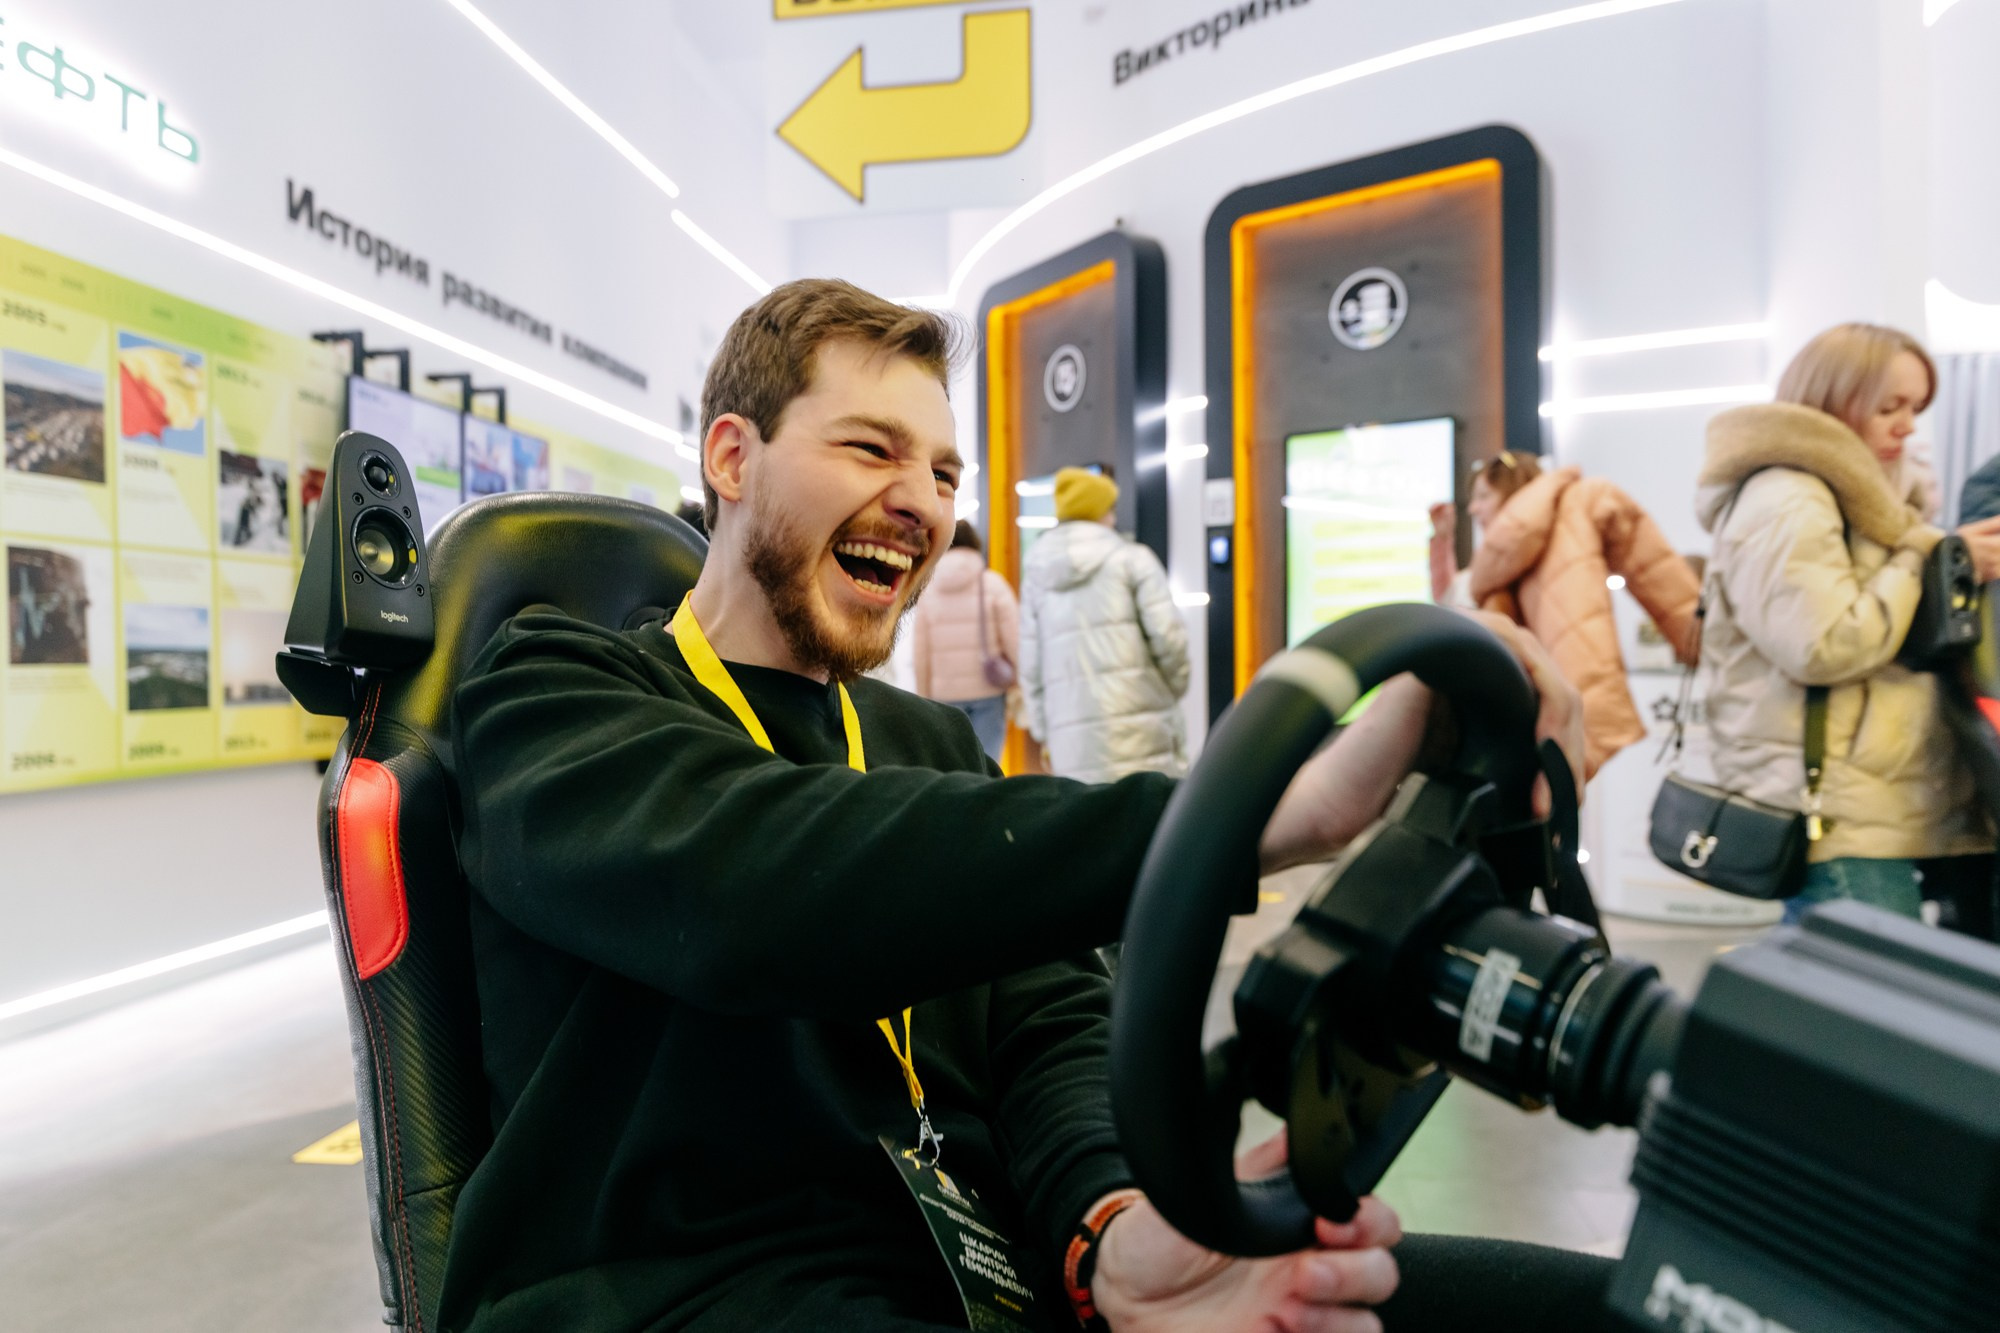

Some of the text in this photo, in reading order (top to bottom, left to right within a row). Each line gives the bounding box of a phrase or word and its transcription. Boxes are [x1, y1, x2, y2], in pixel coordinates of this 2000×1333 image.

[1113, 0, 1311, 86] Викторин
[0, 16, 198, 164] ФТЬ
[286, 178, 430, 287] История
[442, 271, 553, 345] развития
[380, 610, 409, 623] logitech
[959, 1254, 1034, 1302] ГЕННАДЬЕВИЧ
[964, 1245, 1017, 1281] ДМИТРИЙ
